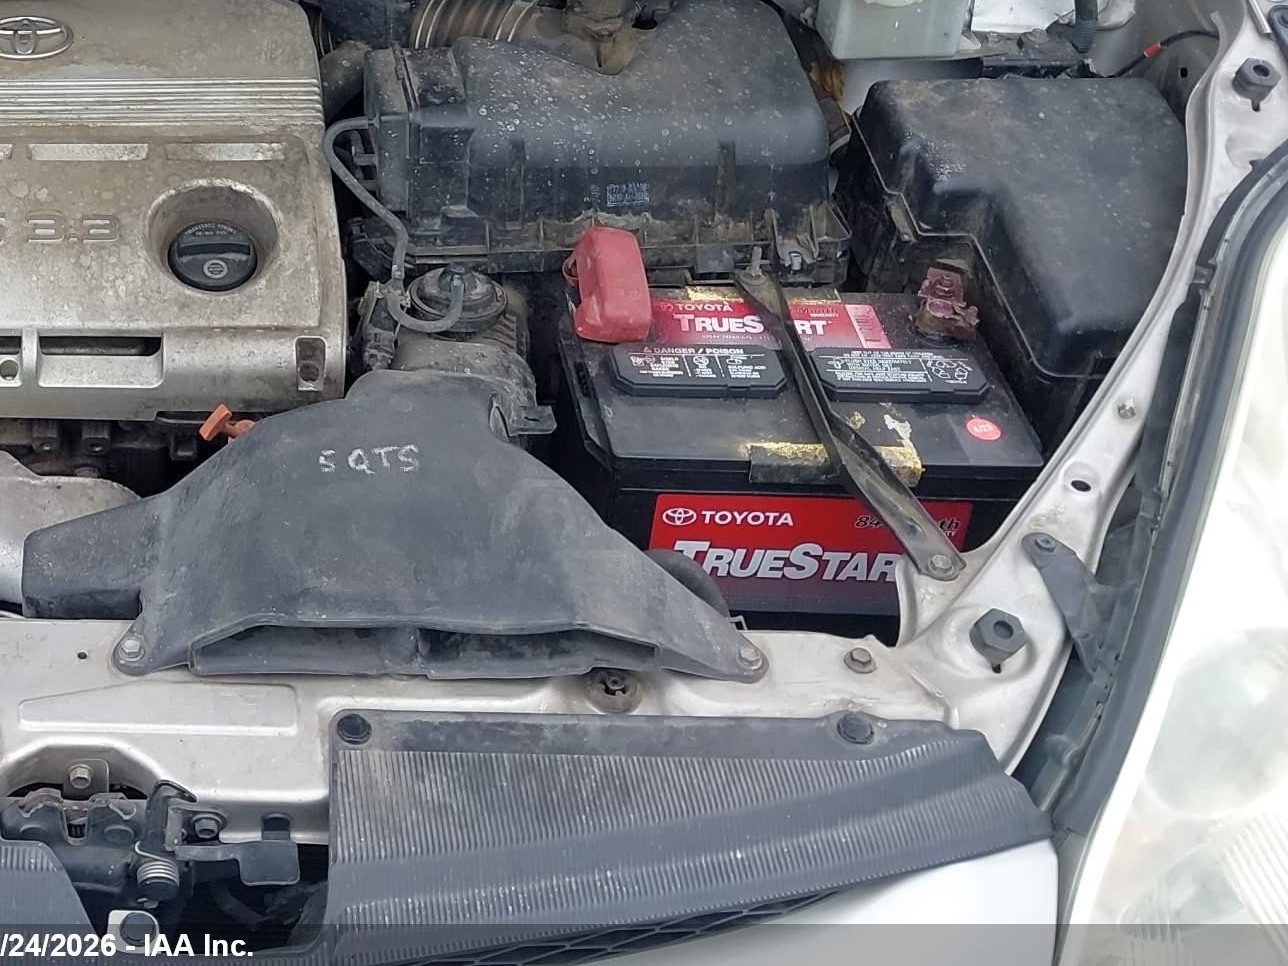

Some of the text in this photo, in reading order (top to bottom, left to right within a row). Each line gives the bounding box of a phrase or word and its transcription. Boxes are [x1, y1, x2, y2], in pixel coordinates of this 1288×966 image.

[26, 213, 121, 244] 3.3
[678, 303, 734, 312] TOYOTA
[654, 346, 696, 354] DANGER
[347, 444, 420, 475] QTS
[701, 510, 794, 527] TOYOTA
